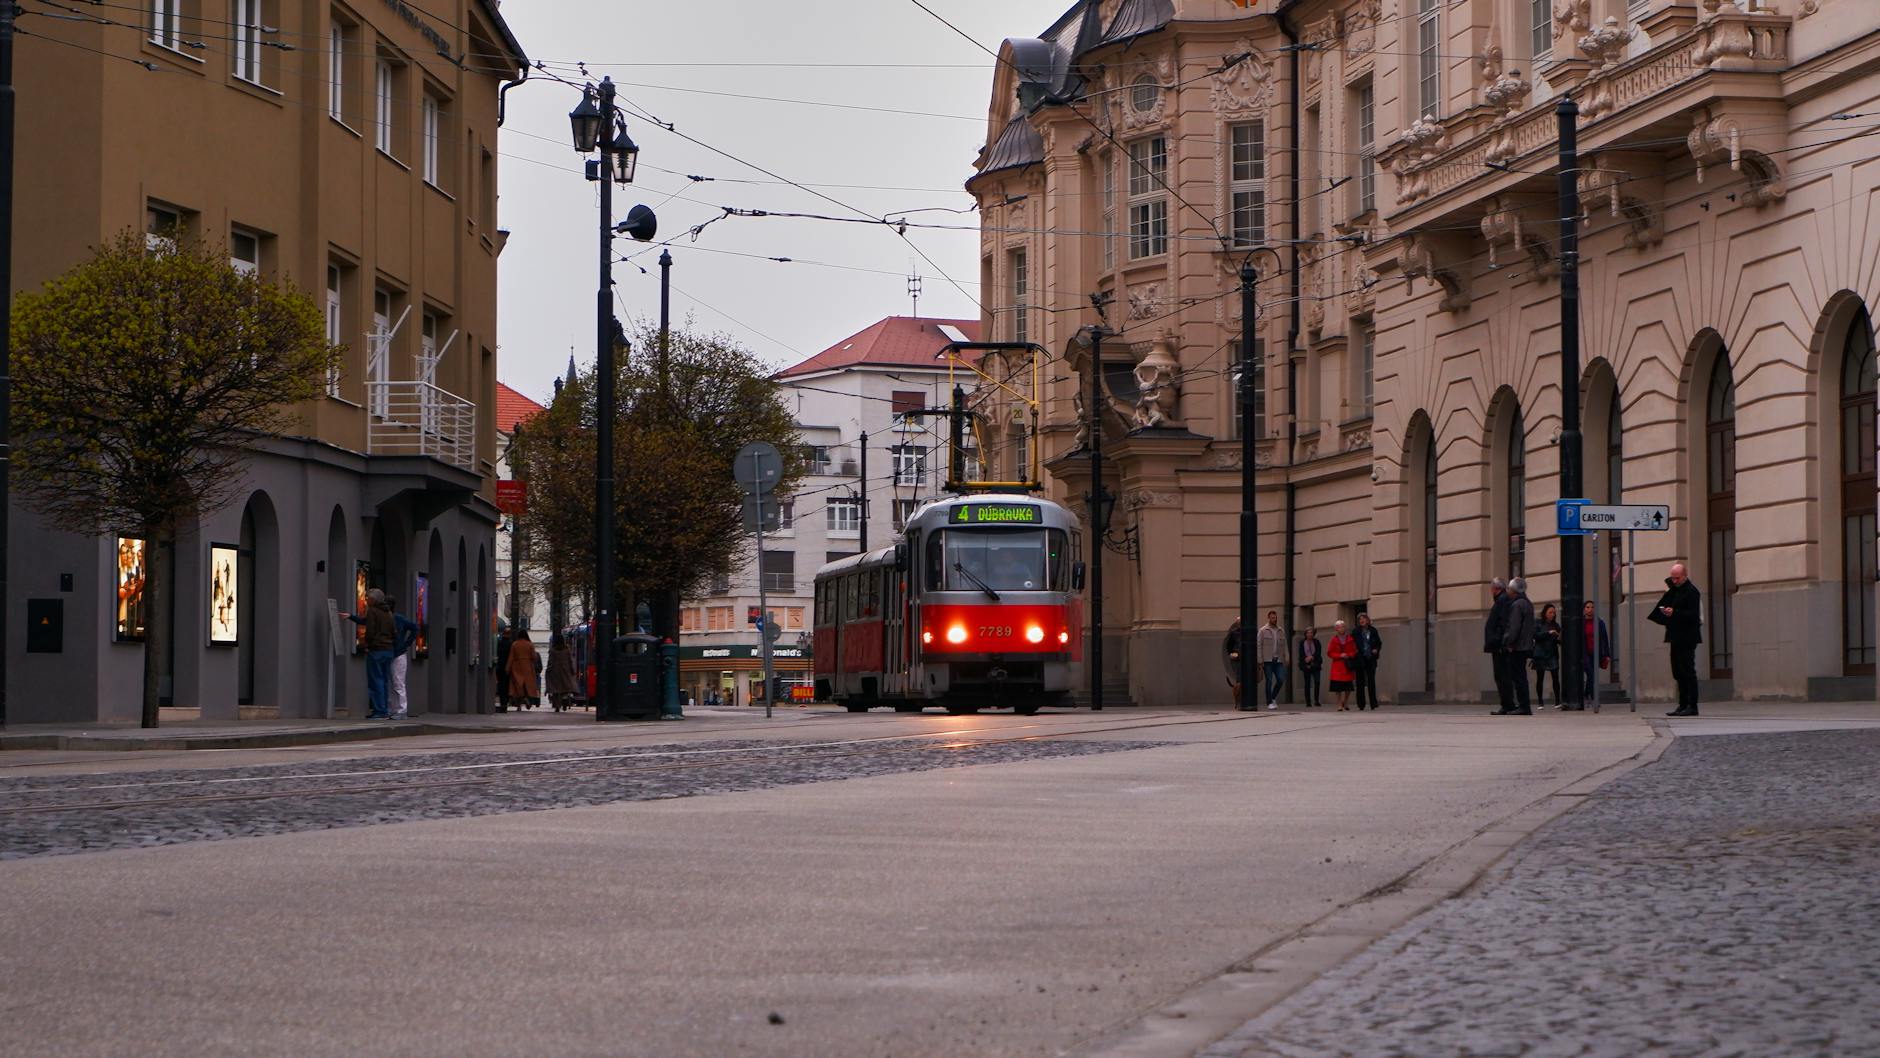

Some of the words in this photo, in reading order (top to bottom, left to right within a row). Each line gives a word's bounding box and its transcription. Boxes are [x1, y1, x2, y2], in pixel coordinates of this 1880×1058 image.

[958, 505, 969, 521] 4
[978, 506, 1033, 521] DÚBRAVKA
[1566, 509, 1574, 522] P
[1582, 513, 1616, 522] CARLTON
[979, 626, 1012, 637] 7789
